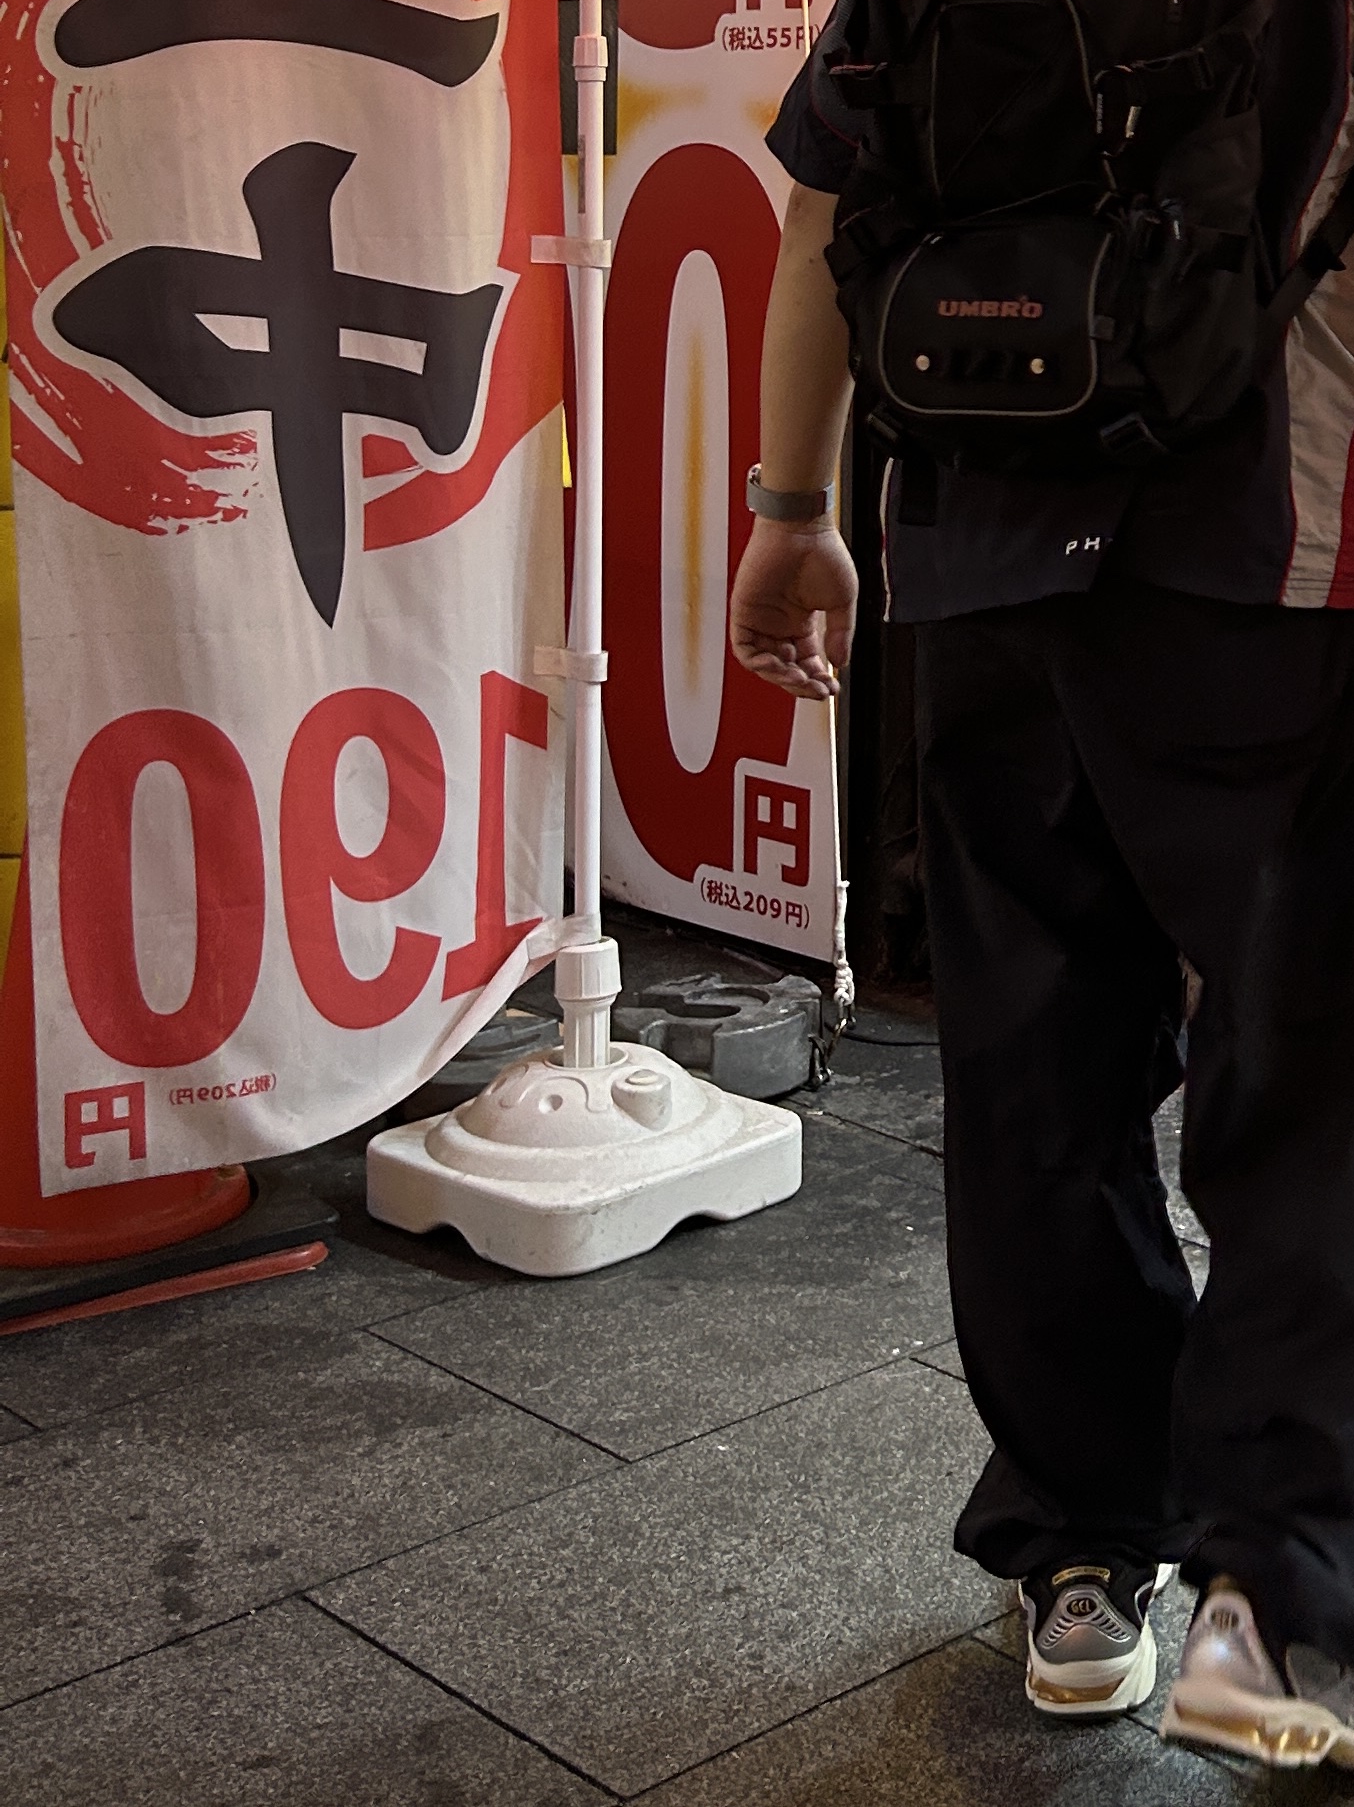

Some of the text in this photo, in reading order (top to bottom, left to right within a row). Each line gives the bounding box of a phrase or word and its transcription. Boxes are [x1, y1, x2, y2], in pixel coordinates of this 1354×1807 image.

[937, 298, 1044, 319] UMBRO
[1065, 536, 1113, 556] PH
[701, 877, 810, 930] (税込209円)
